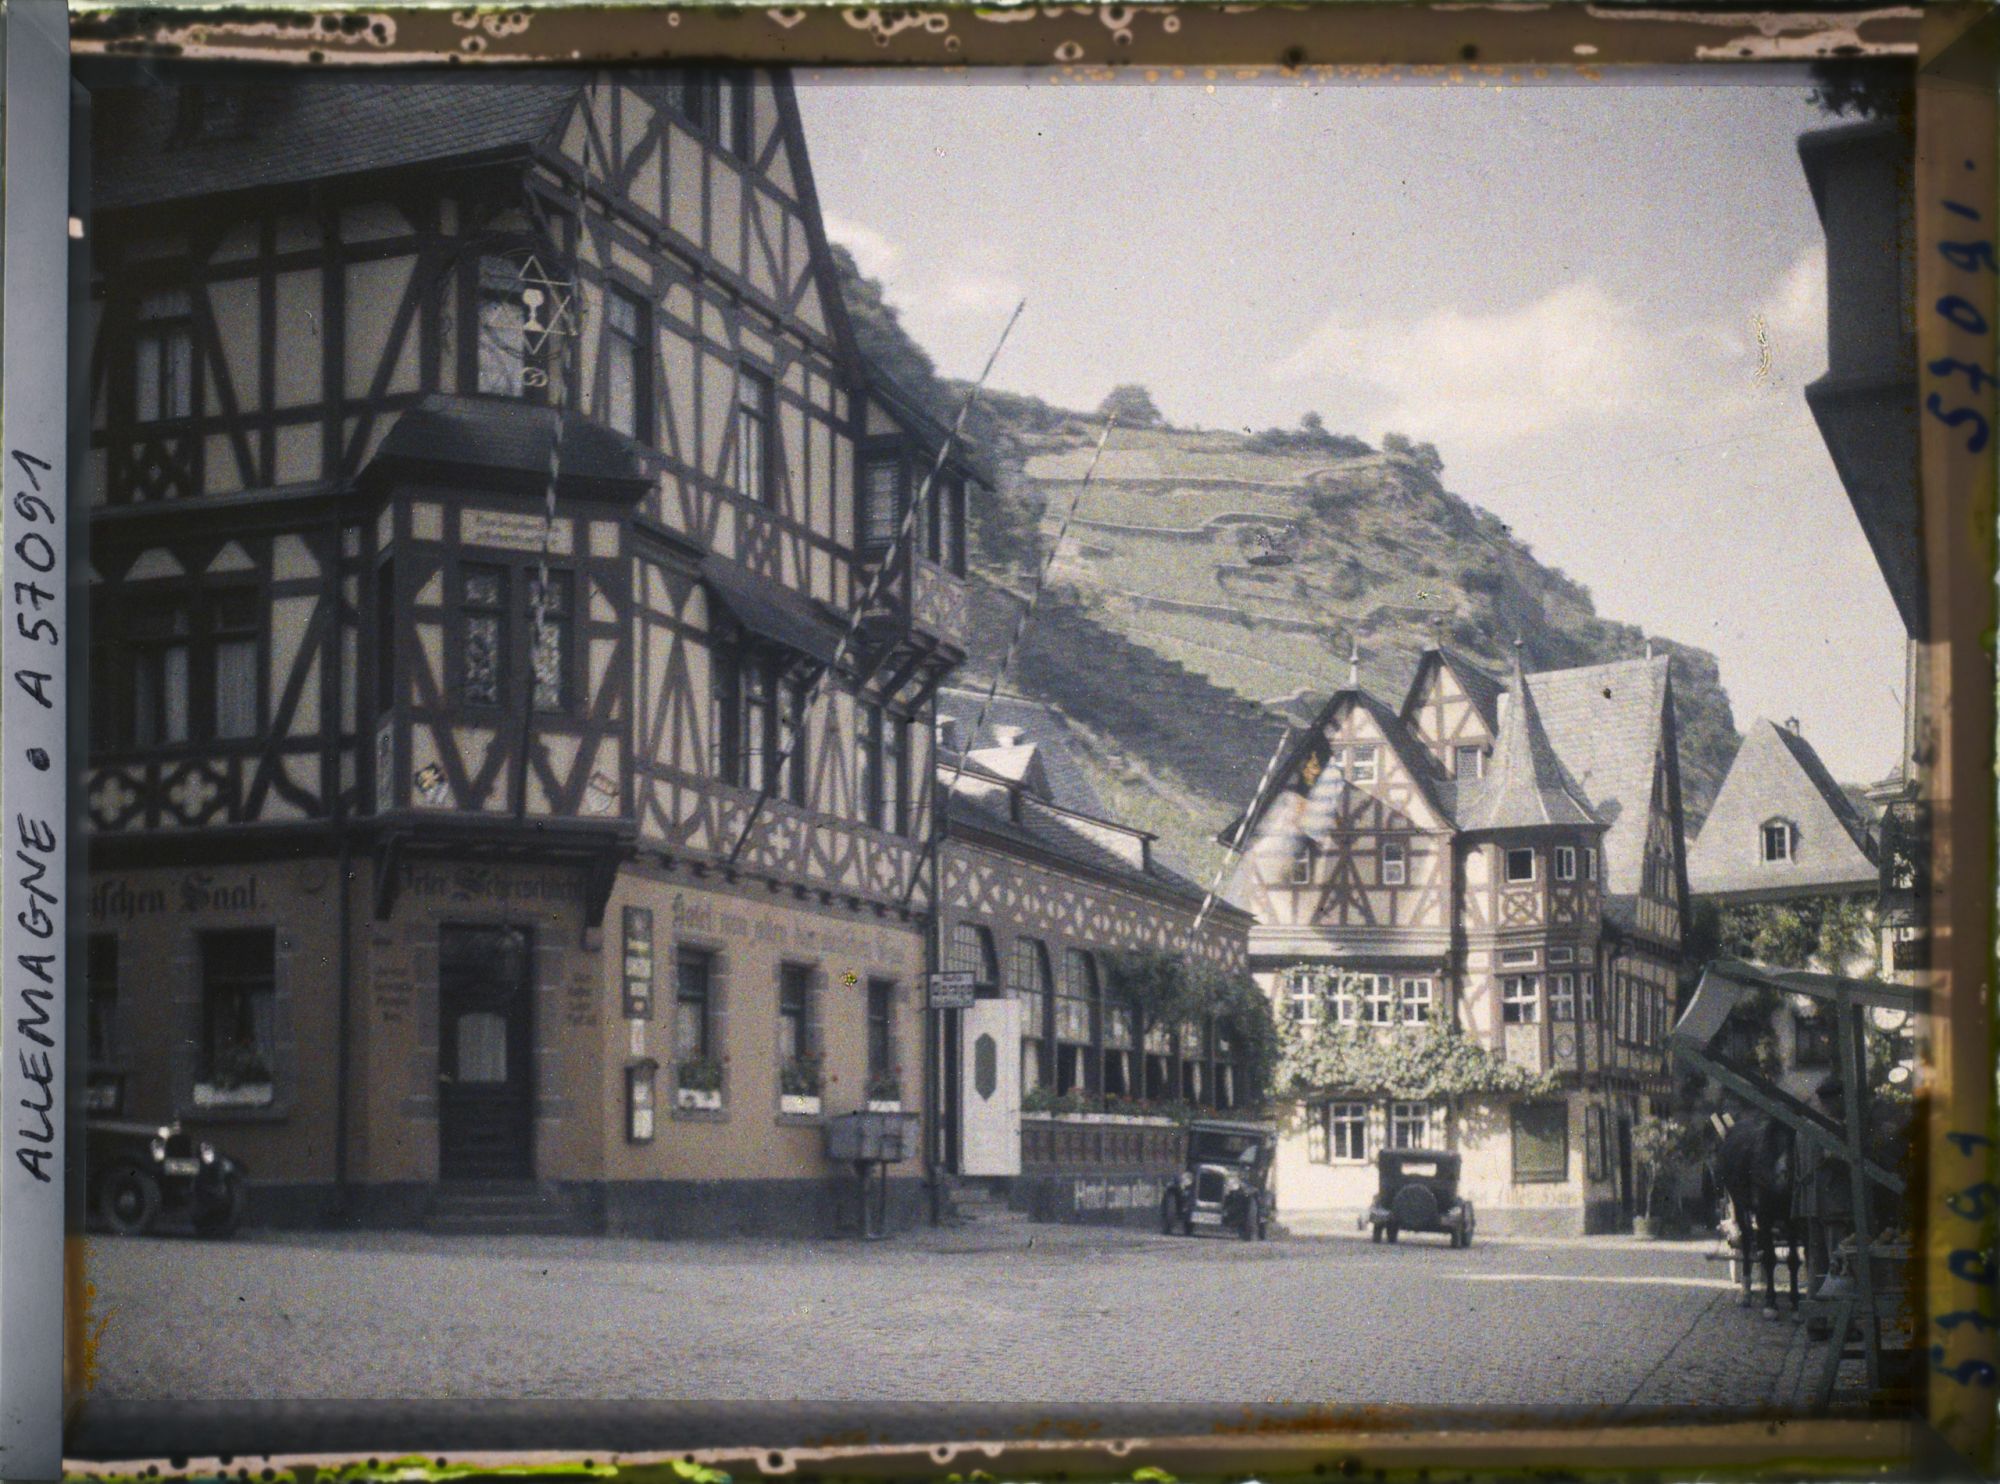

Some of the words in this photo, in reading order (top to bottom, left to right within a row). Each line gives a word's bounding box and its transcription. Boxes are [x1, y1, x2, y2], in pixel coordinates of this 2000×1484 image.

[12, 450, 58, 646] 57091
[22, 672, 53, 709] A
[14, 810, 56, 1182] ALLEMAGNE
